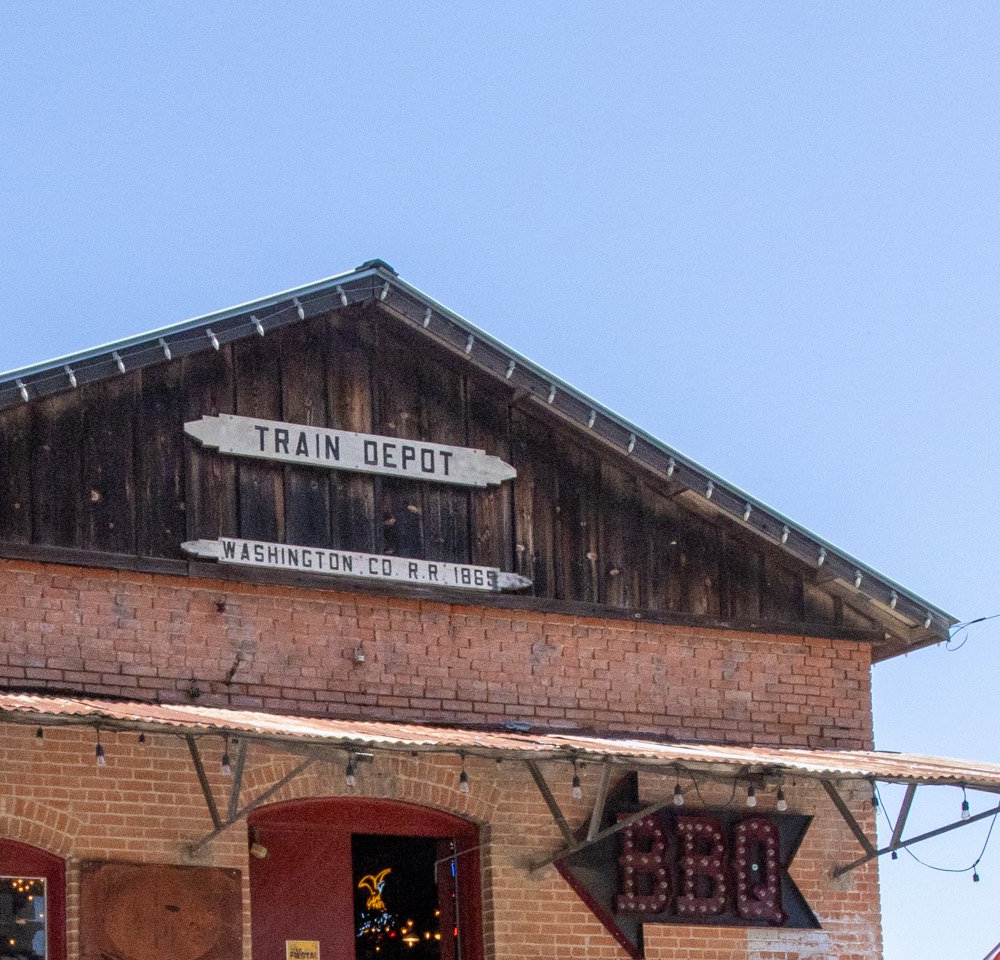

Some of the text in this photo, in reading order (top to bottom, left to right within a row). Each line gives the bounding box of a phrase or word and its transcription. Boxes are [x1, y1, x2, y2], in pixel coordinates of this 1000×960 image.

[254, 425, 453, 476] TRAIN DEPOT
[222, 540, 353, 573] WASHINGTON
[453, 566, 499, 589] 1865
[617, 813, 788, 927] BBQ
